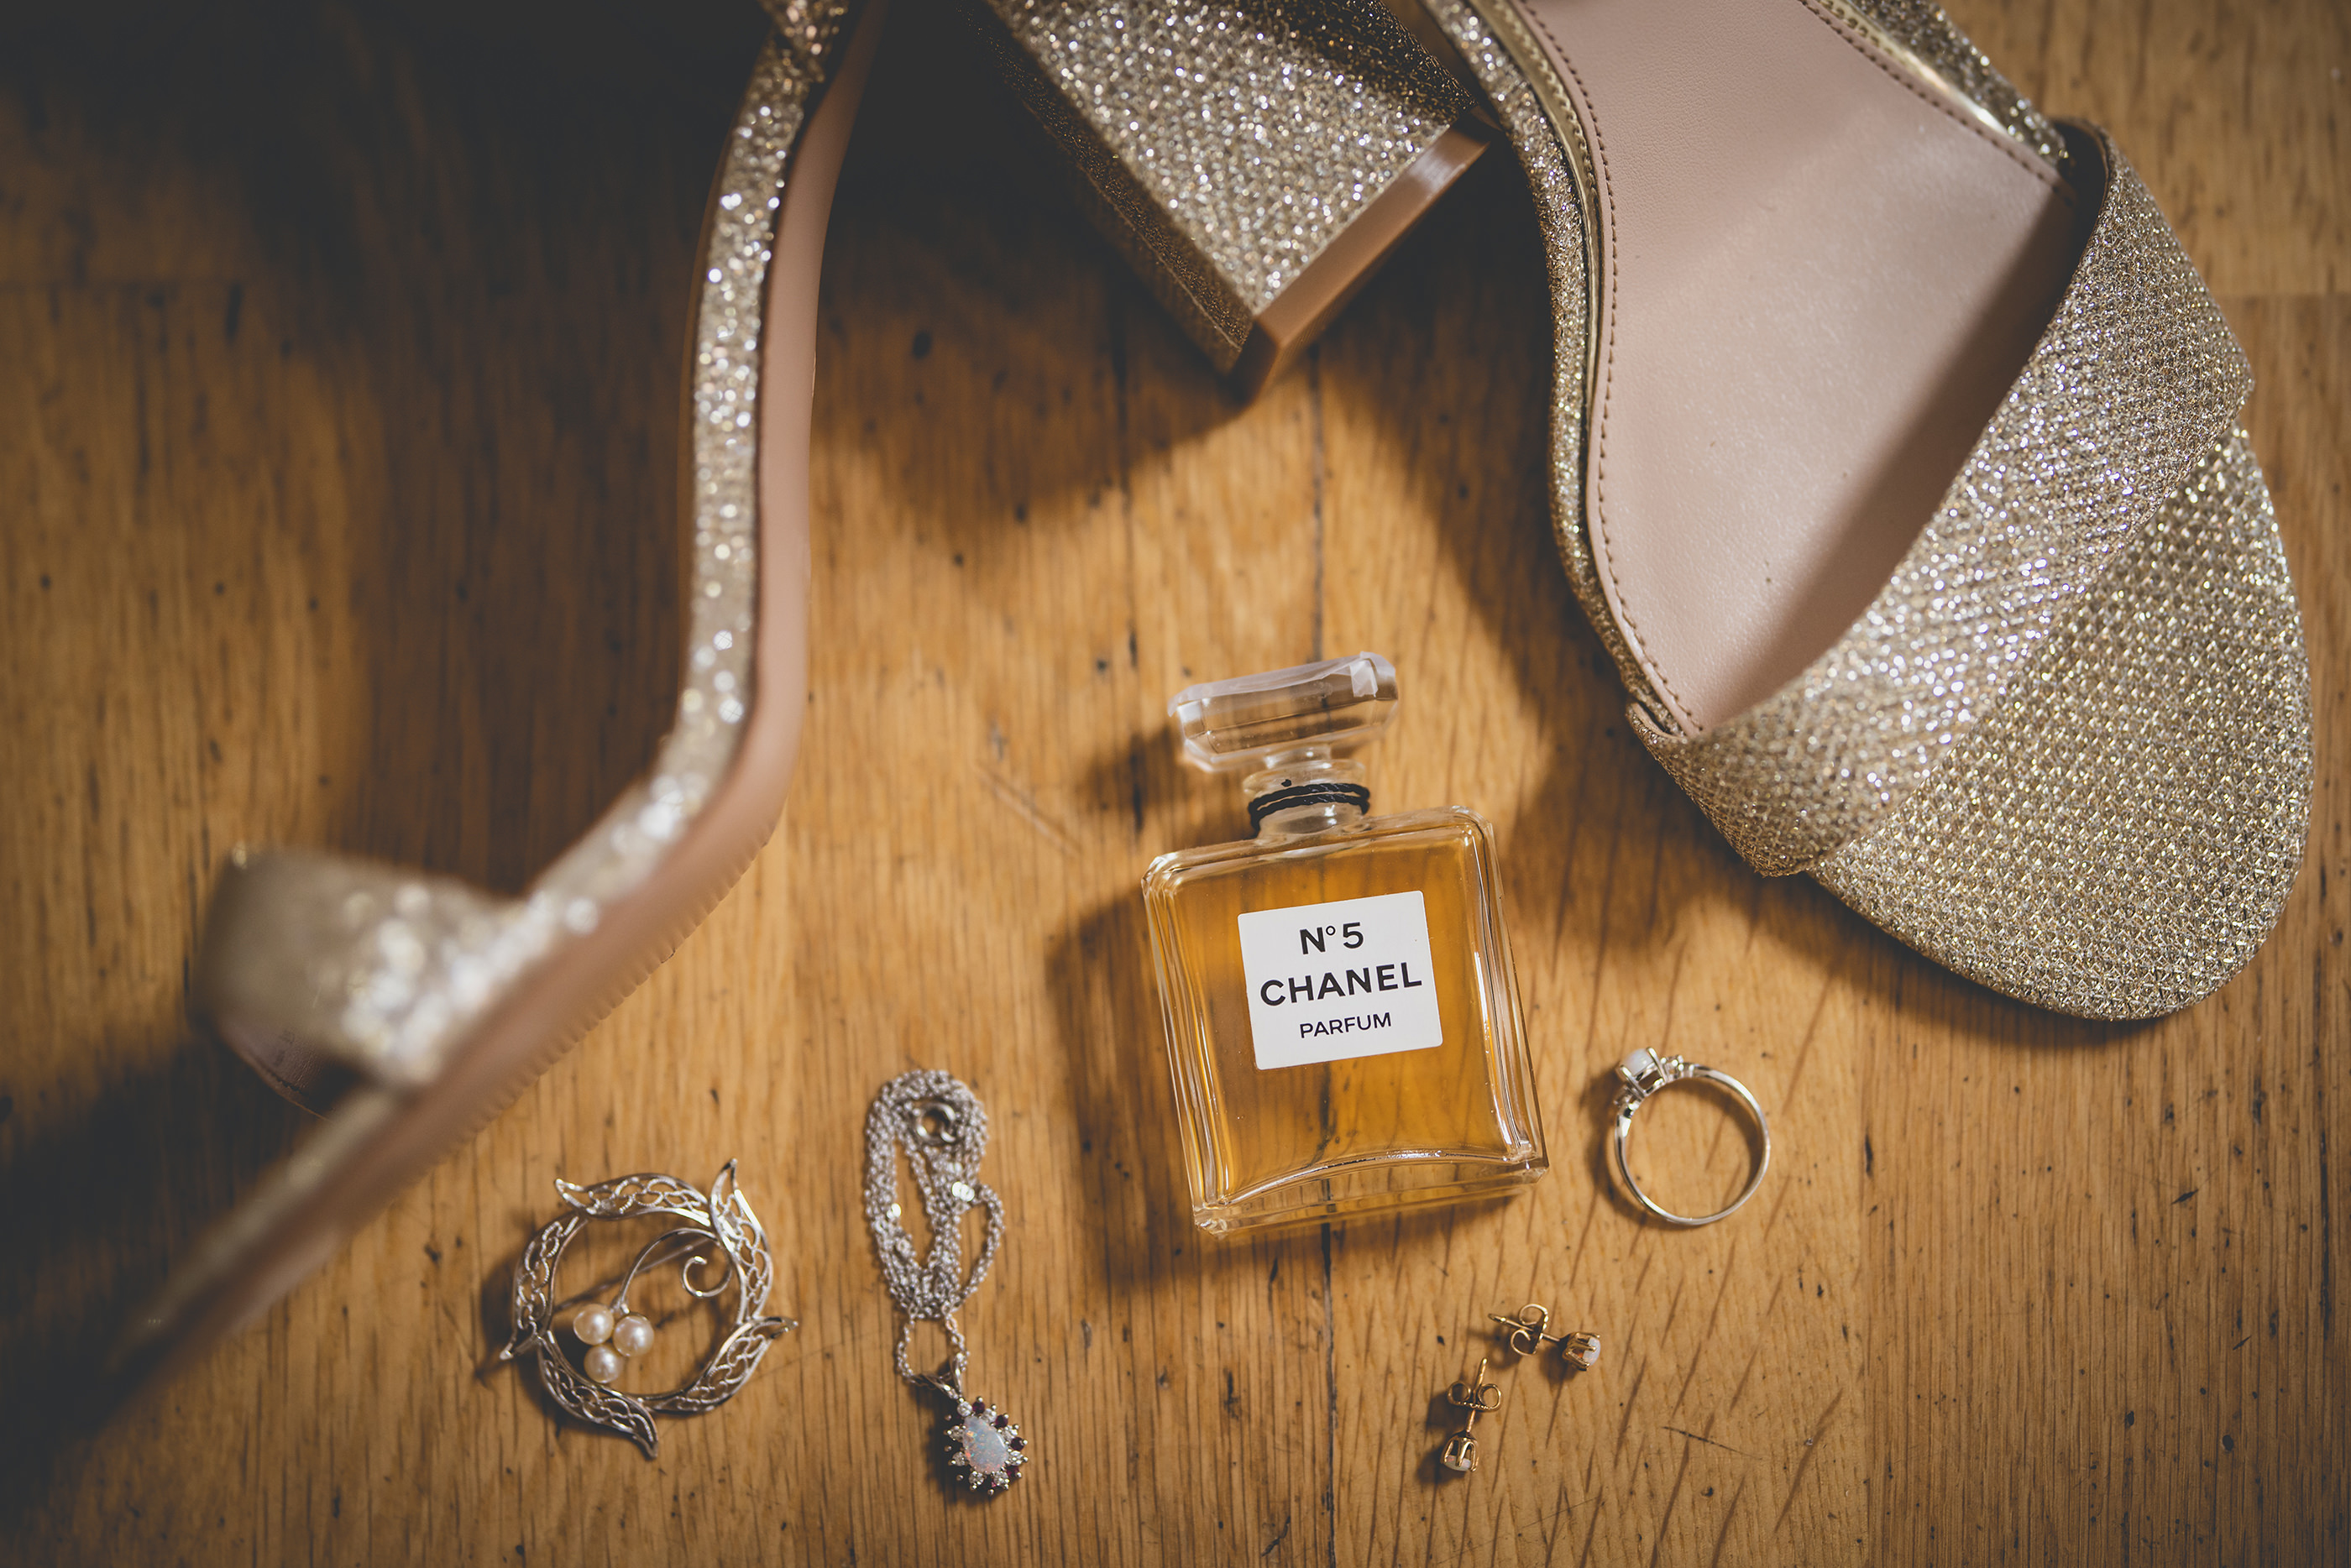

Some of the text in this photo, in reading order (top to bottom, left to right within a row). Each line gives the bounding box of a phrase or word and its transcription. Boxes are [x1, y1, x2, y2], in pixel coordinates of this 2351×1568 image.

[1343, 922, 1364, 949] 5
[1260, 962, 1422, 1006] CHANEL
[1300, 1011, 1391, 1038] PARFUM
